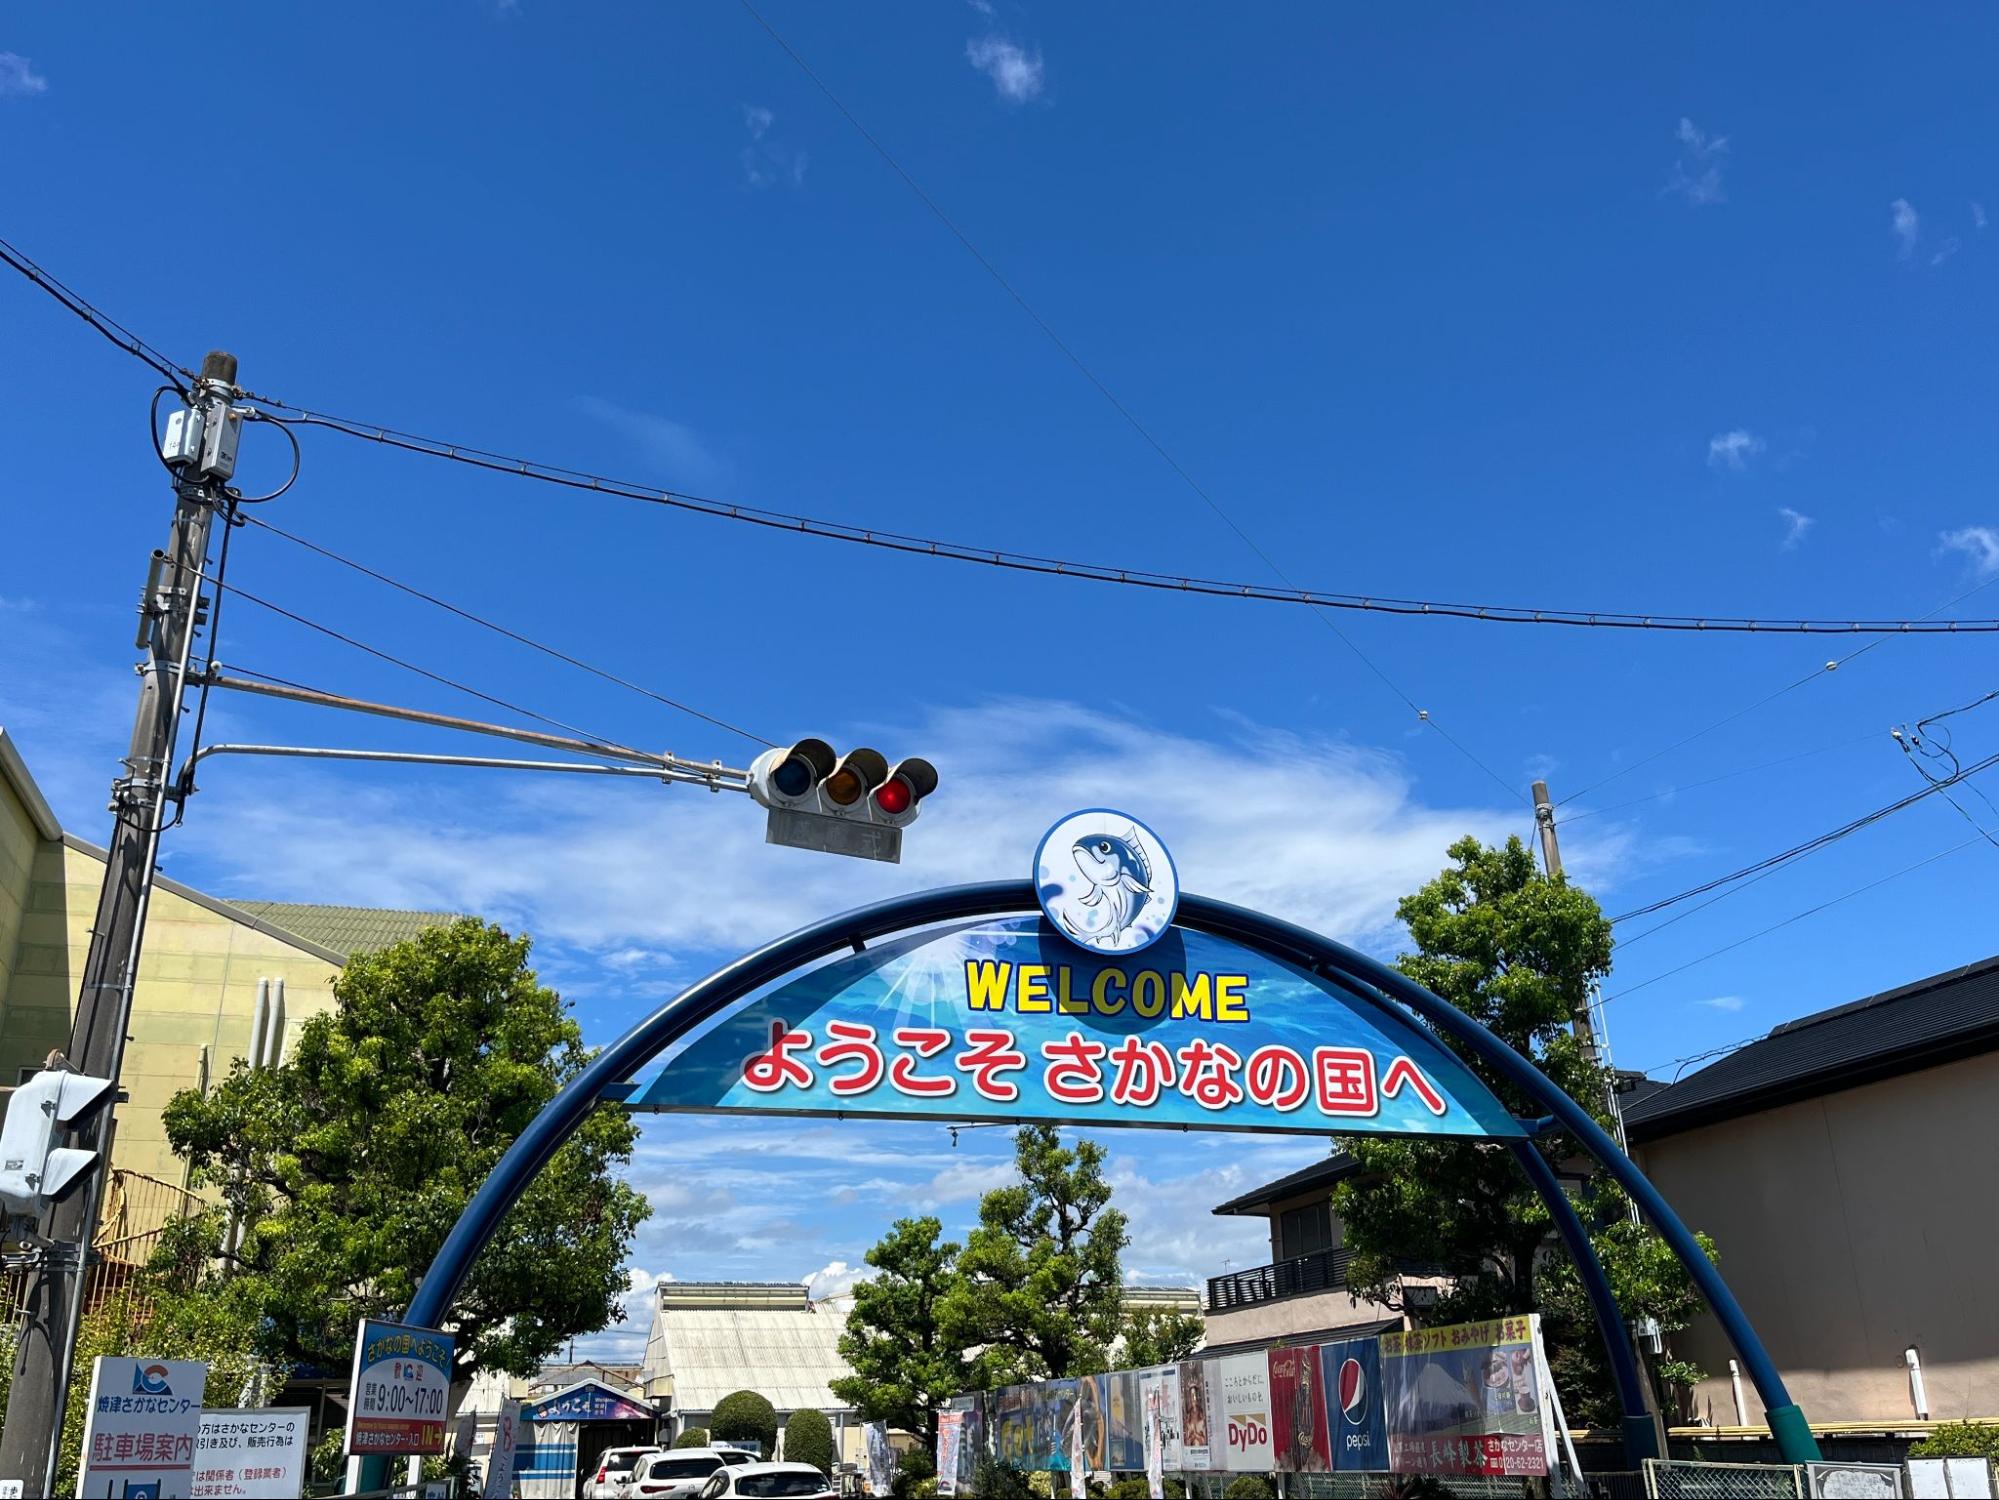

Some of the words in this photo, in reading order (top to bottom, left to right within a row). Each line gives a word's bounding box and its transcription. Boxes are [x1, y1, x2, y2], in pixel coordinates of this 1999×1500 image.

[965, 959, 1249, 1022] WELCOME
[742, 1017, 1025, 1101] ようこそ
[1041, 1031, 1447, 1117] さかなの国へ
[1451, 1322, 1490, 1346] おみやげ
[97, 1395, 201, 1414] 焼津さかなセンター
[92, 1432, 193, 1461] 駐車場案内
[421, 1424, 434, 1446] IN
[1229, 1422, 1268, 1452] DyDo
[1346, 1430, 1371, 1451] pepsi
[1488, 1439, 1543, 1453] さかなセンター店
[192, 1467, 287, 1481] は関係者（登録業者）
